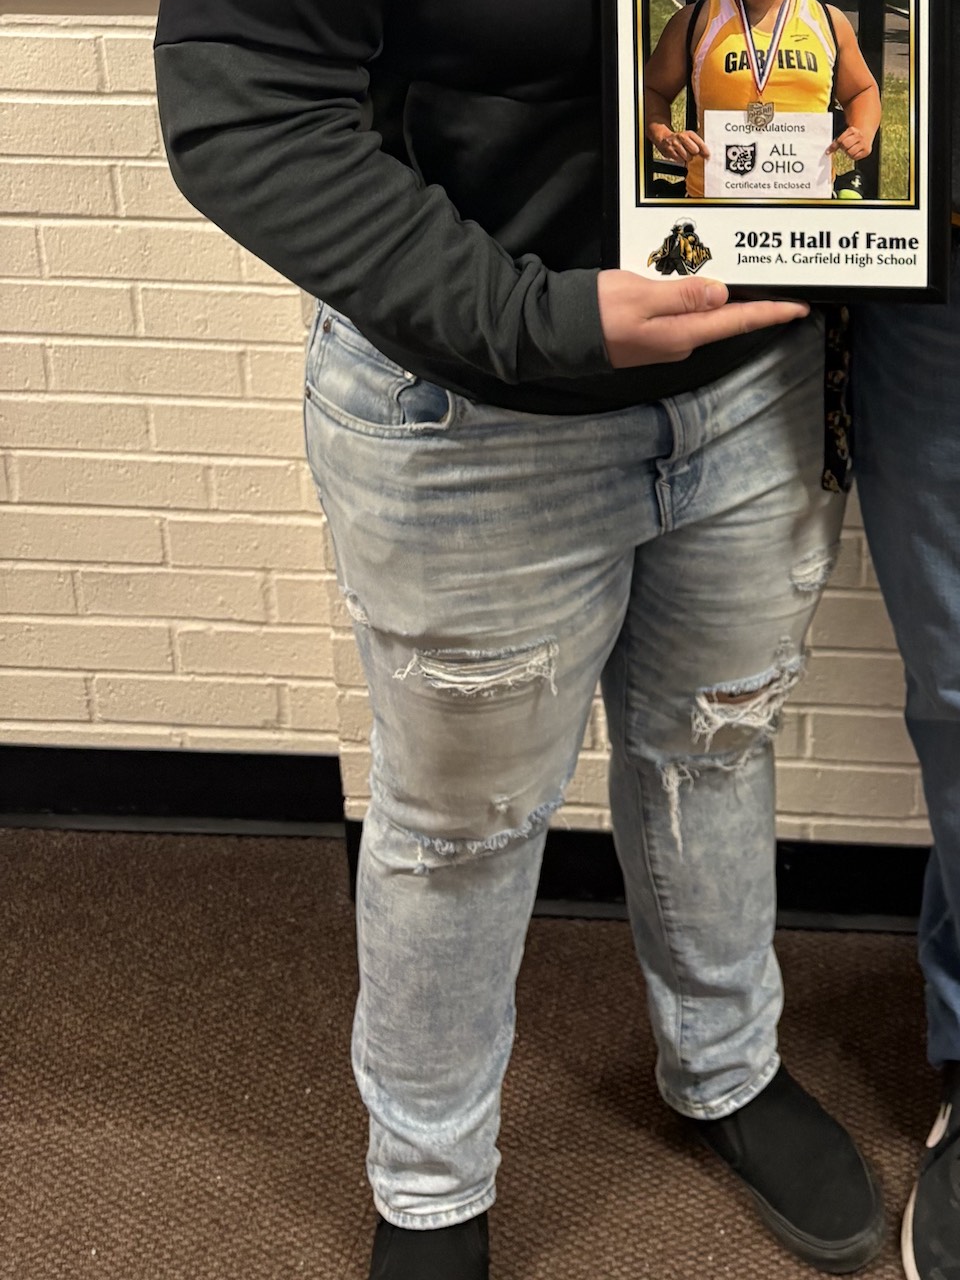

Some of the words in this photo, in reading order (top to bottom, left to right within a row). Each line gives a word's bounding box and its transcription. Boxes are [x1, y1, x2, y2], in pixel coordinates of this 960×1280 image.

[770, 144, 796, 156] ALL
[762, 161, 804, 174] OHIO
[725, 181, 771, 190] Certificates
[774, 181, 811, 190] Enclosed
[734, 231, 782, 248] 2025
[790, 231, 831, 248] Hall
[838, 232, 860, 249] of
[866, 232, 920, 250] Fame
[737, 253, 772, 265] James
[775, 254, 788, 264] A.
[792, 252, 840, 264] Garfield
[846, 254, 872, 267] High
[877, 253, 917, 266] School
